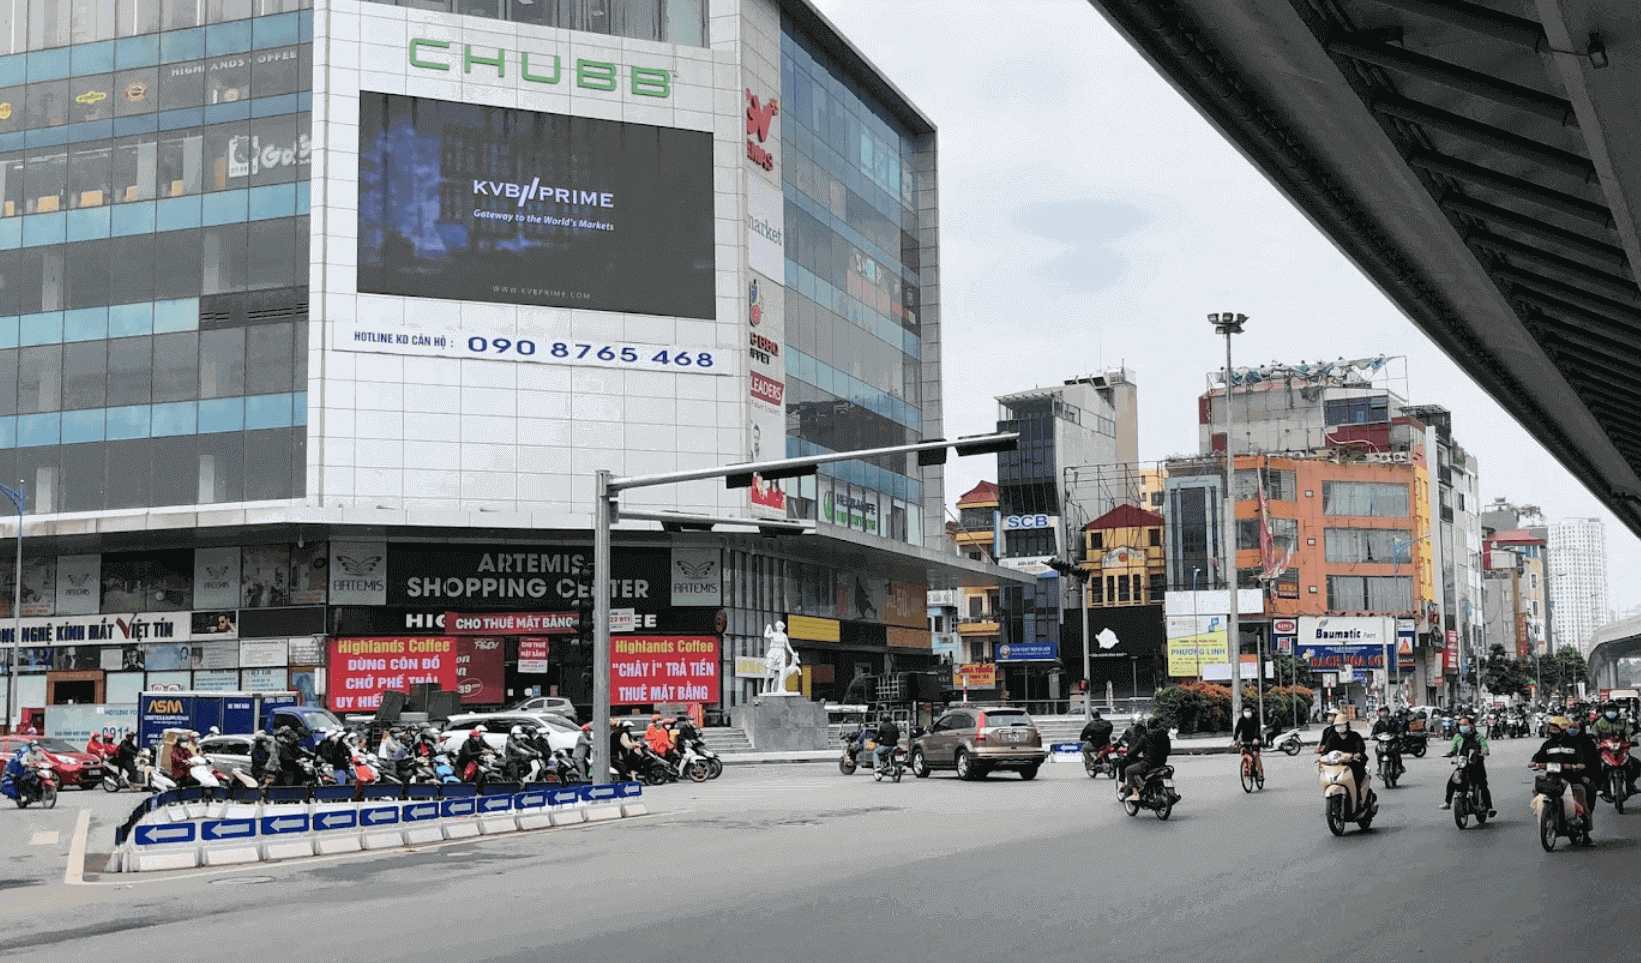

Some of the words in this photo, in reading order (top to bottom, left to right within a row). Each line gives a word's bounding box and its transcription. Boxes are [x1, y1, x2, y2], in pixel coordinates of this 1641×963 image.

[409, 38, 671, 98] CHUBB
[473, 209, 514, 222] Gateway
[515, 213, 525, 222] to
[527, 214, 542, 224] the
[543, 216, 577, 227] World's
[579, 220, 615, 232] Markets
[354, 331, 393, 344] HOTLINE
[396, 335, 409, 345] KD
[434, 336, 447, 350] HỘ
[468, 336, 536, 356] 090
[550, 342, 639, 363] 8765
[652, 350, 714, 368] 468
[1007, 515, 1048, 528] SCB
[477, 553, 585, 573] ARTEMIS
[333, 579, 385, 593] ARTEMIS
[406, 577, 548, 598] SHOPPING
[673, 581, 718, 594] ARTEMIS
[21, 622, 53, 645] NGHỆ
[56, 621, 85, 642] KÍNH
[88, 616, 114, 641] MẮT
[116, 611, 150, 643] VIỆT
[153, 617, 174, 638] TÍN
[455, 618, 481, 630] CHO
[483, 615, 514, 630] THUÊ
[516, 615, 540, 633] MẶT
[1315, 628, 1361, 640] Baumatic
[338, 640, 405, 655] Highlands
[408, 639, 451, 653] Coffee
[615, 640, 675, 655] Highlands
[677, 640, 715, 653] Coffee
[348, 656, 386, 671] DÙNG
[390, 656, 419, 670] CÔN
[665, 657, 687, 677] TRẢ
[346, 674, 374, 690] CHỞ
[377, 673, 405, 688] PHẾ
[618, 683, 648, 702] THUÊ
[650, 682, 675, 704] MẶT
[677, 680, 708, 701] BẰNG
[148, 700, 184, 714] ASM
[336, 696, 354, 709] UY
